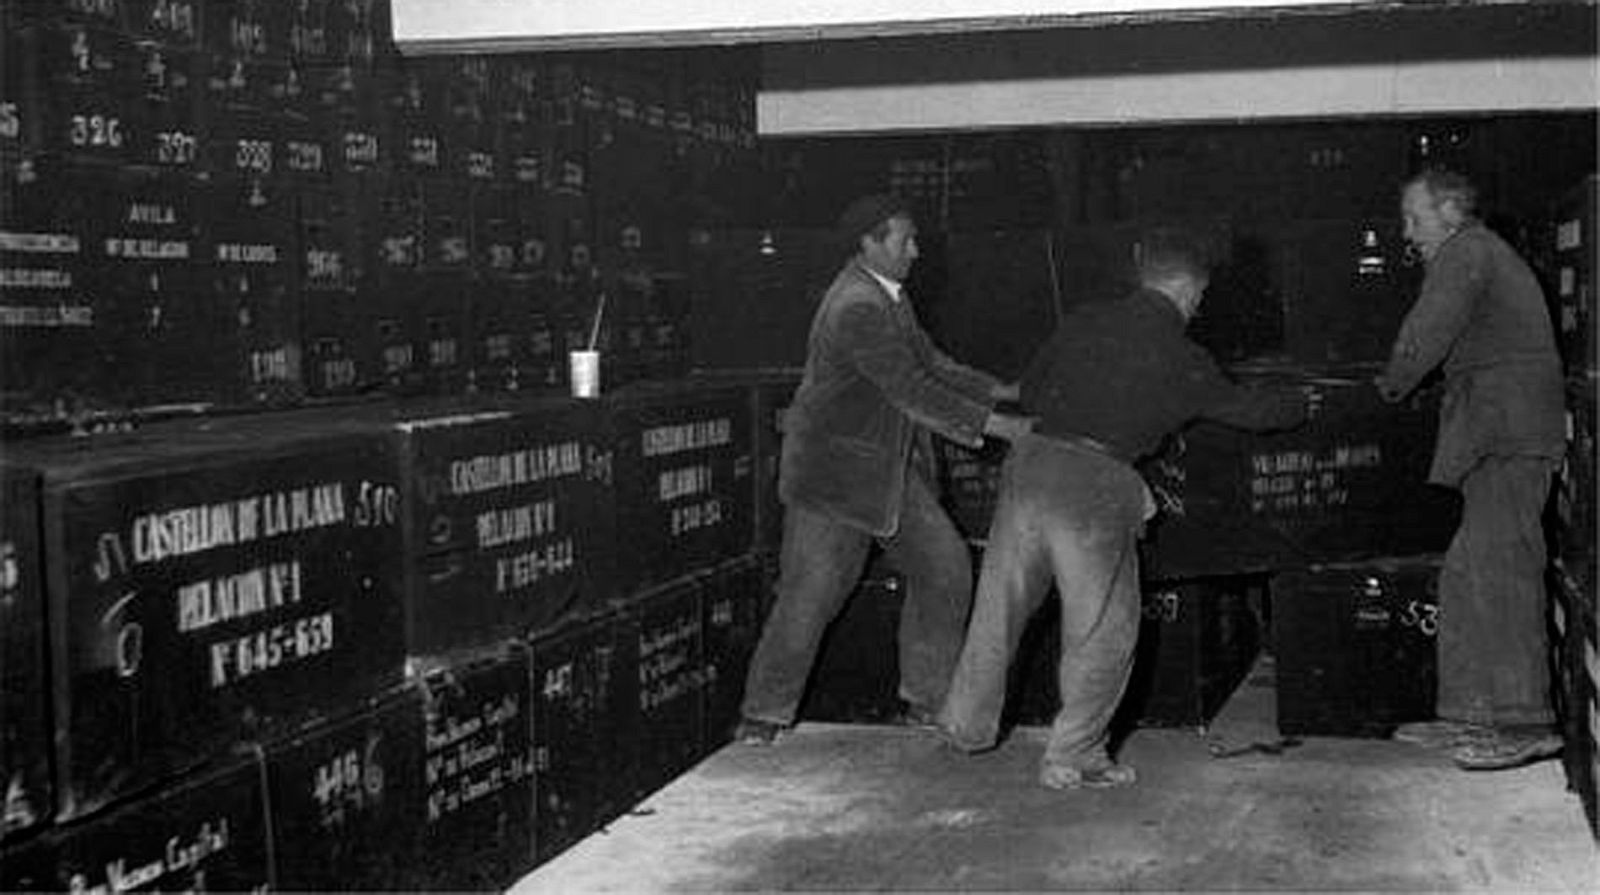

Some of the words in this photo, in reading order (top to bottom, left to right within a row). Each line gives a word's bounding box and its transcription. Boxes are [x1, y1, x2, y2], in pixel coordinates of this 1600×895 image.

[71, 114, 122, 147] 326
[129, 202, 176, 223] AVILA
[133, 502, 235, 563] CASTELLON
[262, 493, 288, 537] LA
[290, 482, 346, 532] PLANA
[177, 567, 266, 632] RELACION
[237, 612, 333, 677] 645-659
